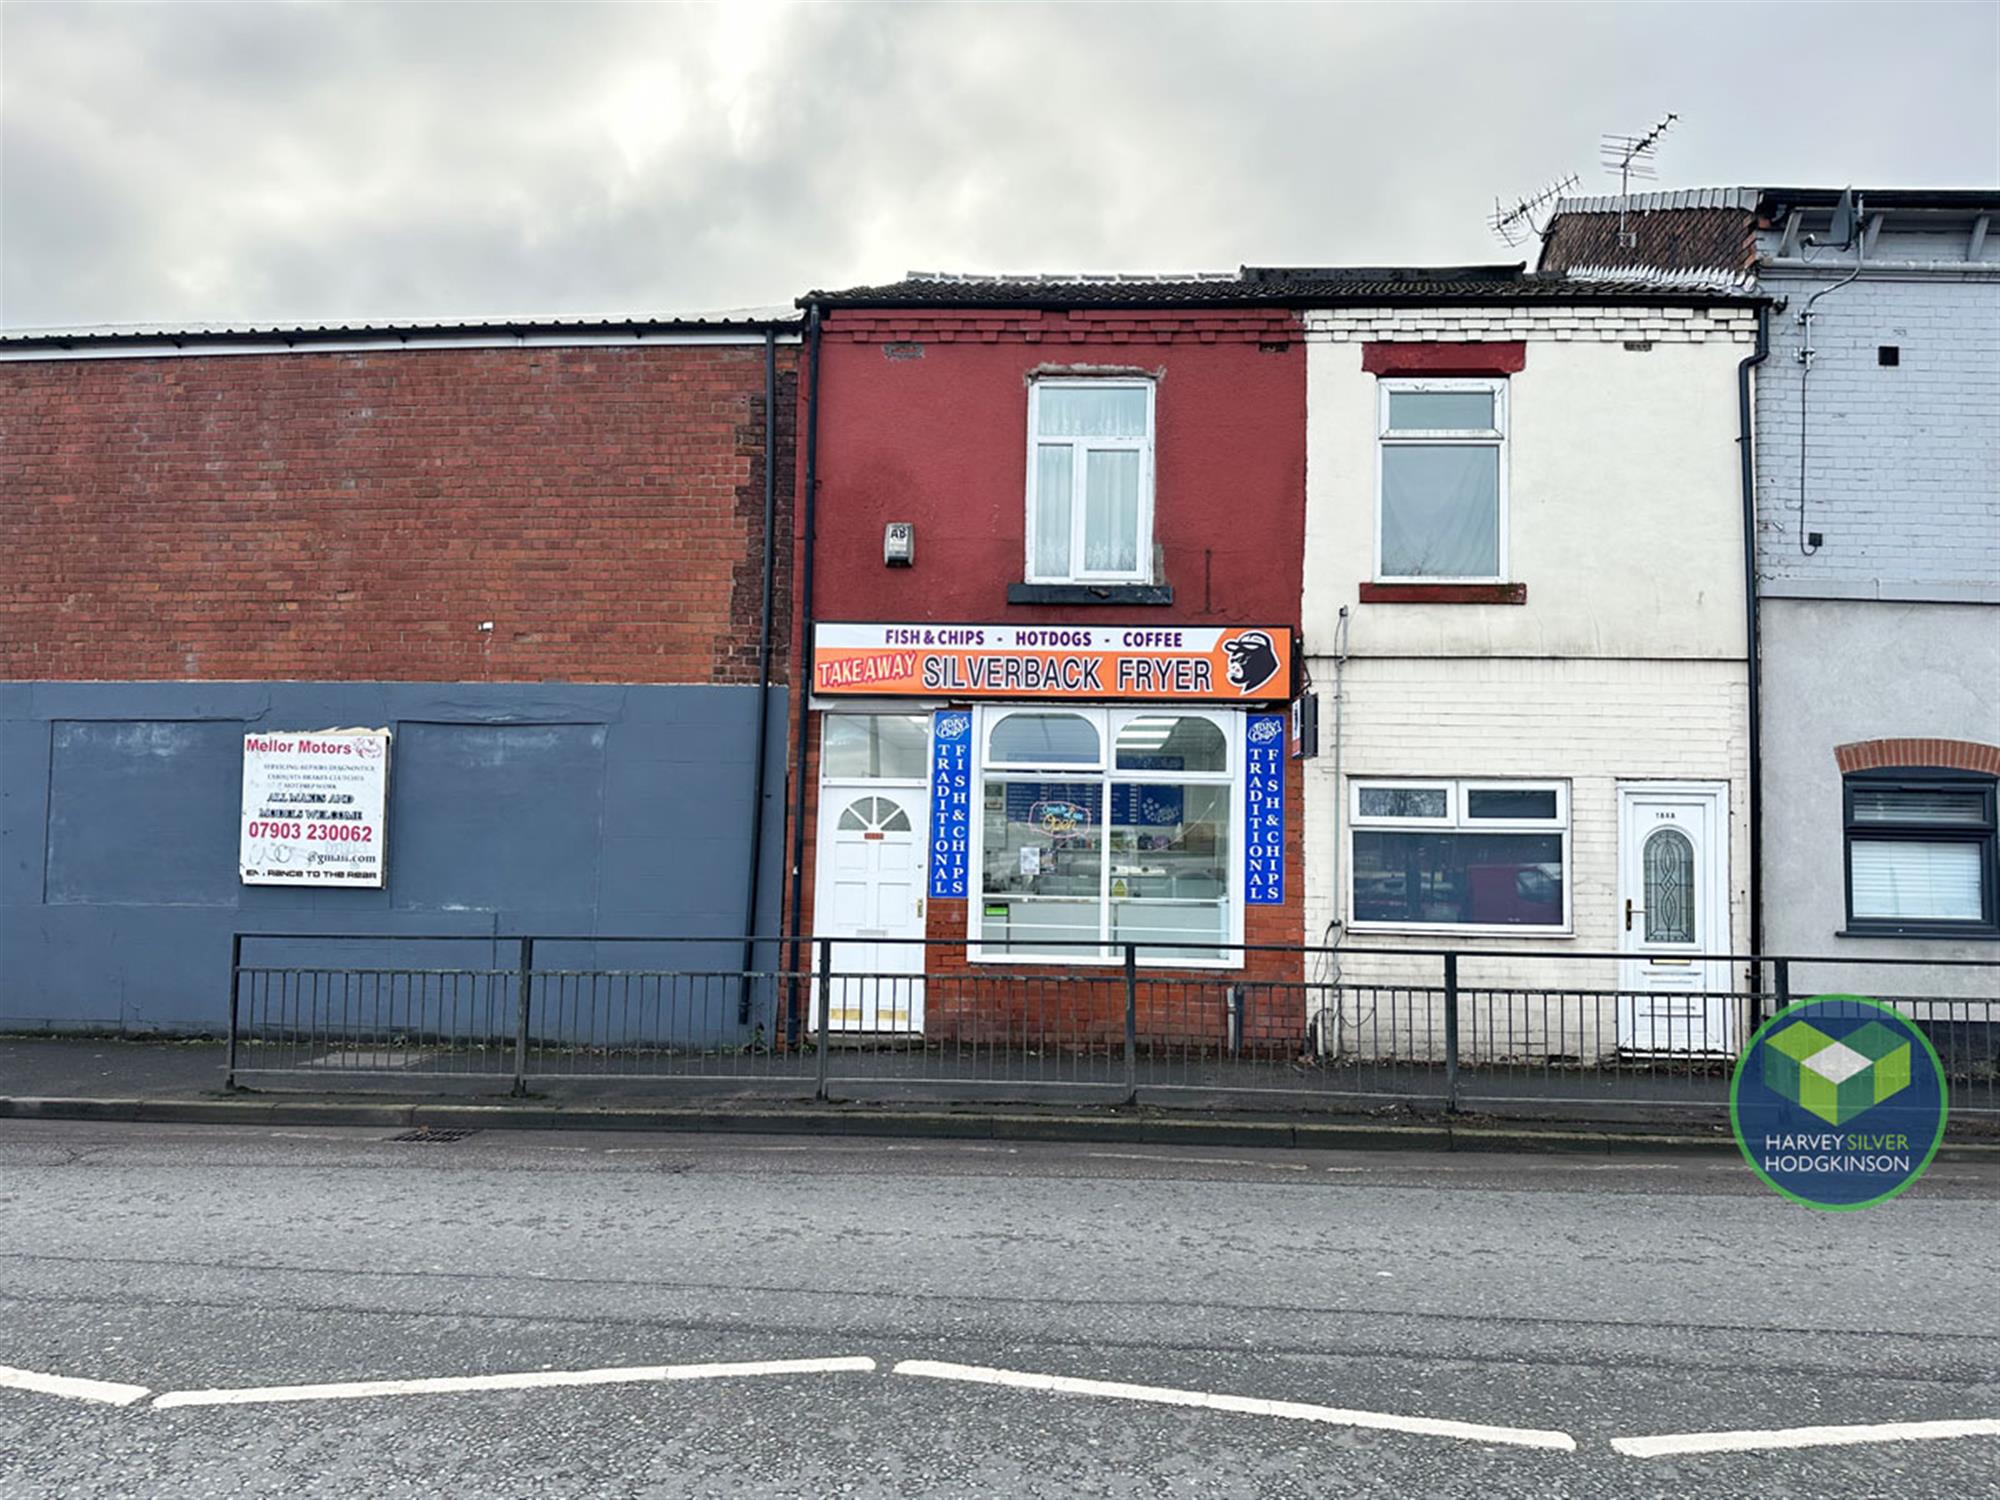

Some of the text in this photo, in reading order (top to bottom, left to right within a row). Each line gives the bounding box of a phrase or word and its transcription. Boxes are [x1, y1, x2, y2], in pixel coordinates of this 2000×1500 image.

[1016, 631, 1092, 646] HOTDOGS
[1123, 632, 1183, 647] COFFEE
[922, 655, 1213, 692] SILVERBACK FRYER
[246, 739, 351, 755] Mellor Motors
[935, 744, 950, 893] TRADITIONAL
[1249, 749, 1263, 899] TRADITIONAL
[249, 822, 372, 842] 07903 230062
[306, 870, 321, 878] TO
